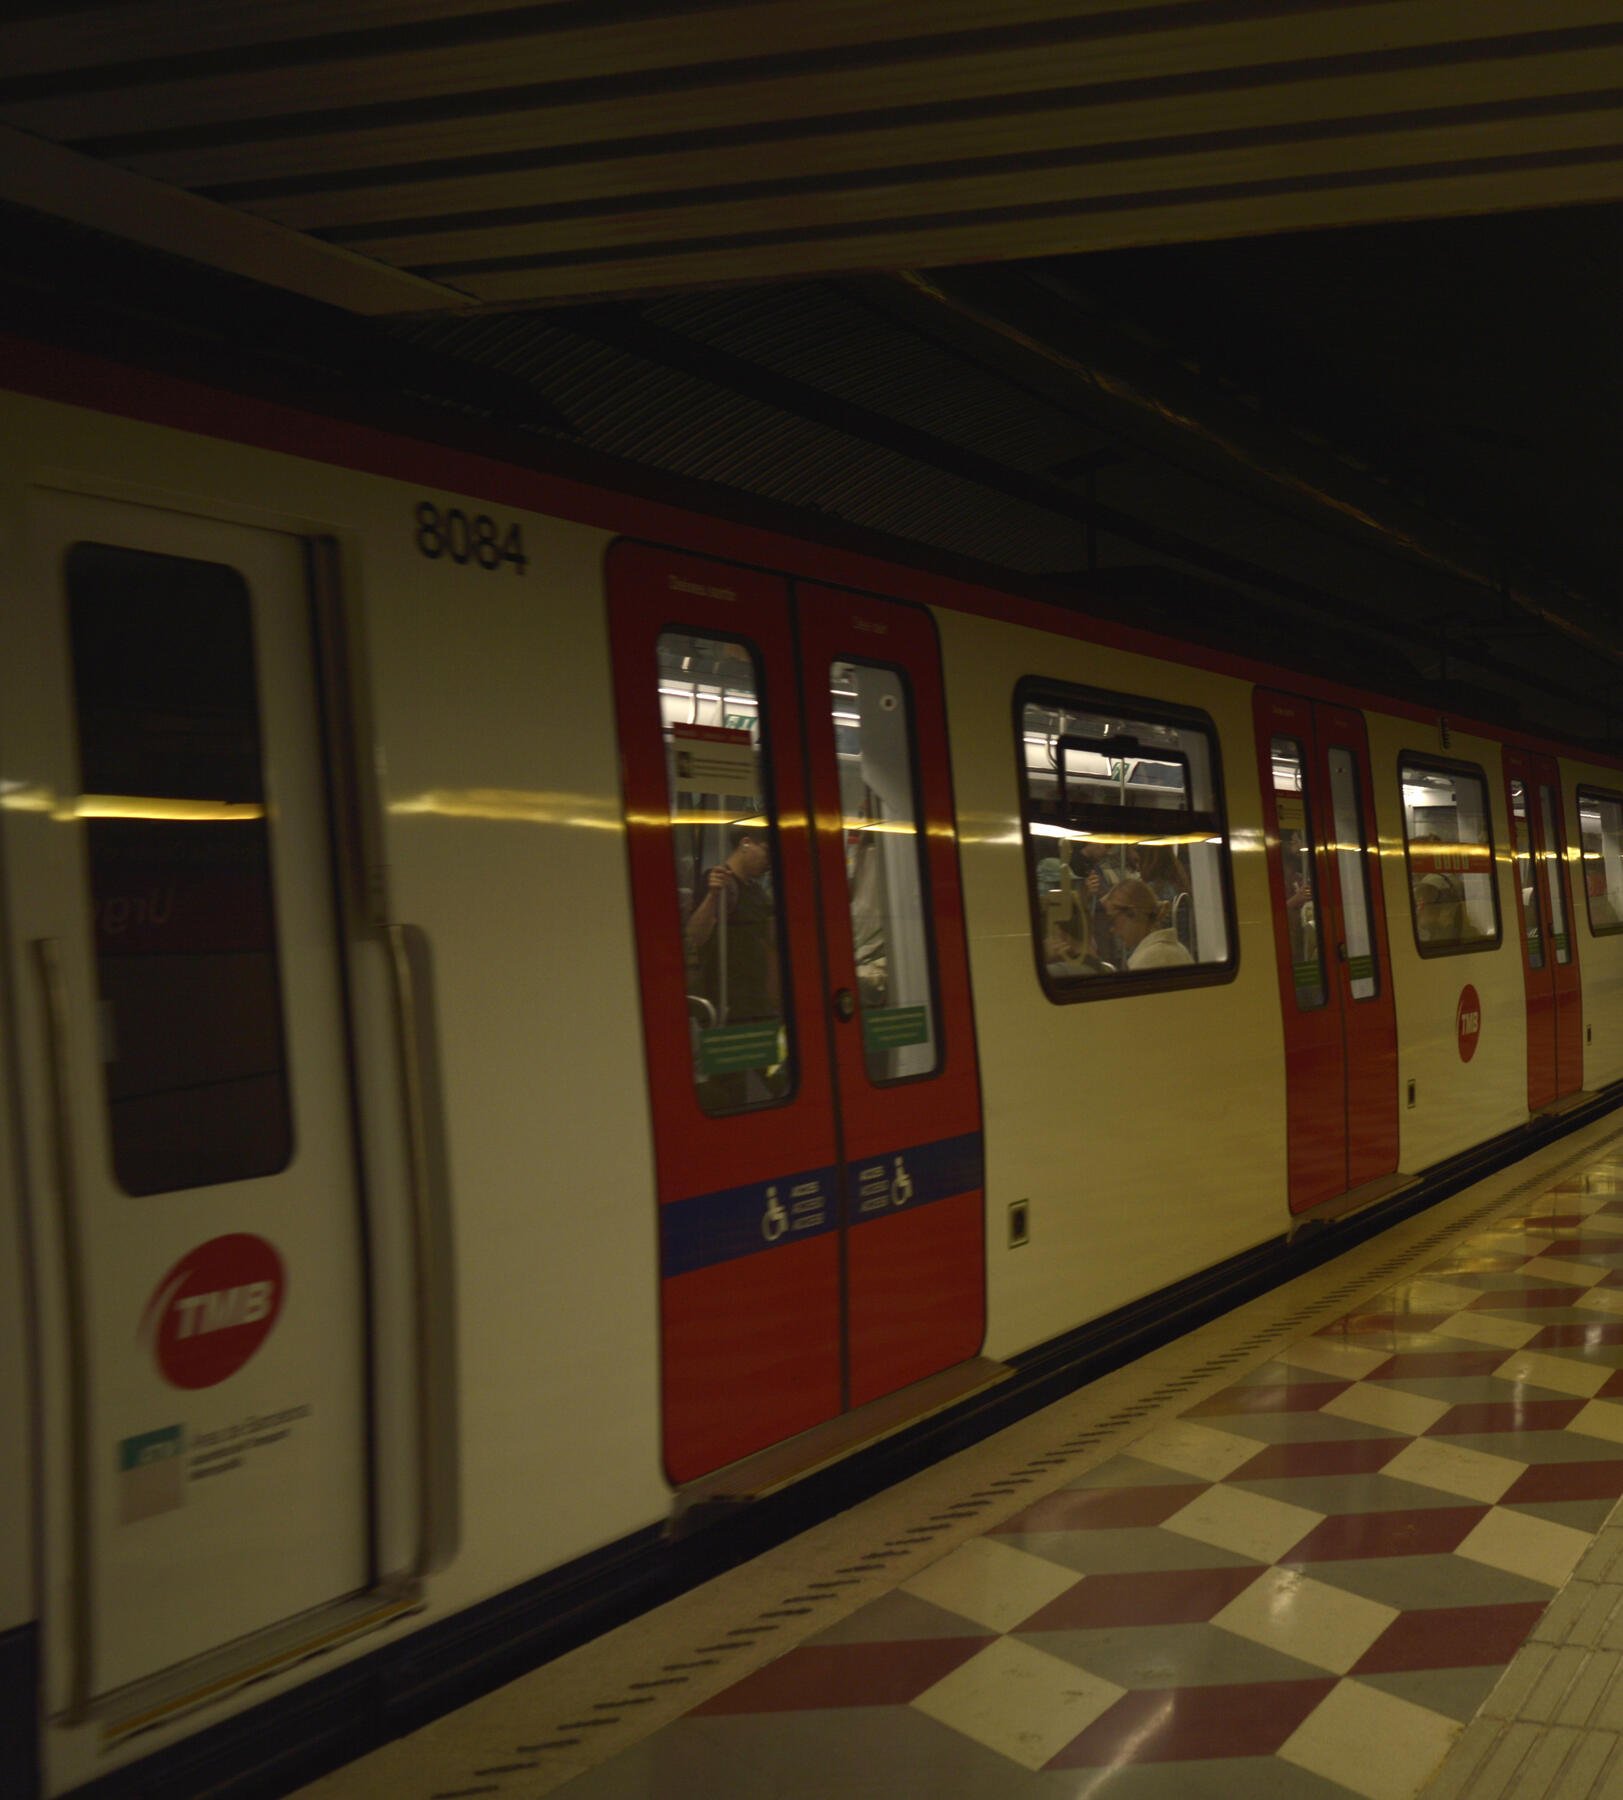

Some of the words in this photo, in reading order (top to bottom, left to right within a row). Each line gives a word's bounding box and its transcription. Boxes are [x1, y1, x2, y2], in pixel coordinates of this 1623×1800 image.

[416, 502, 527, 575] 8084
[1461, 1011, 1479, 1035] TMB
[173, 1280, 276, 1341] TMB
